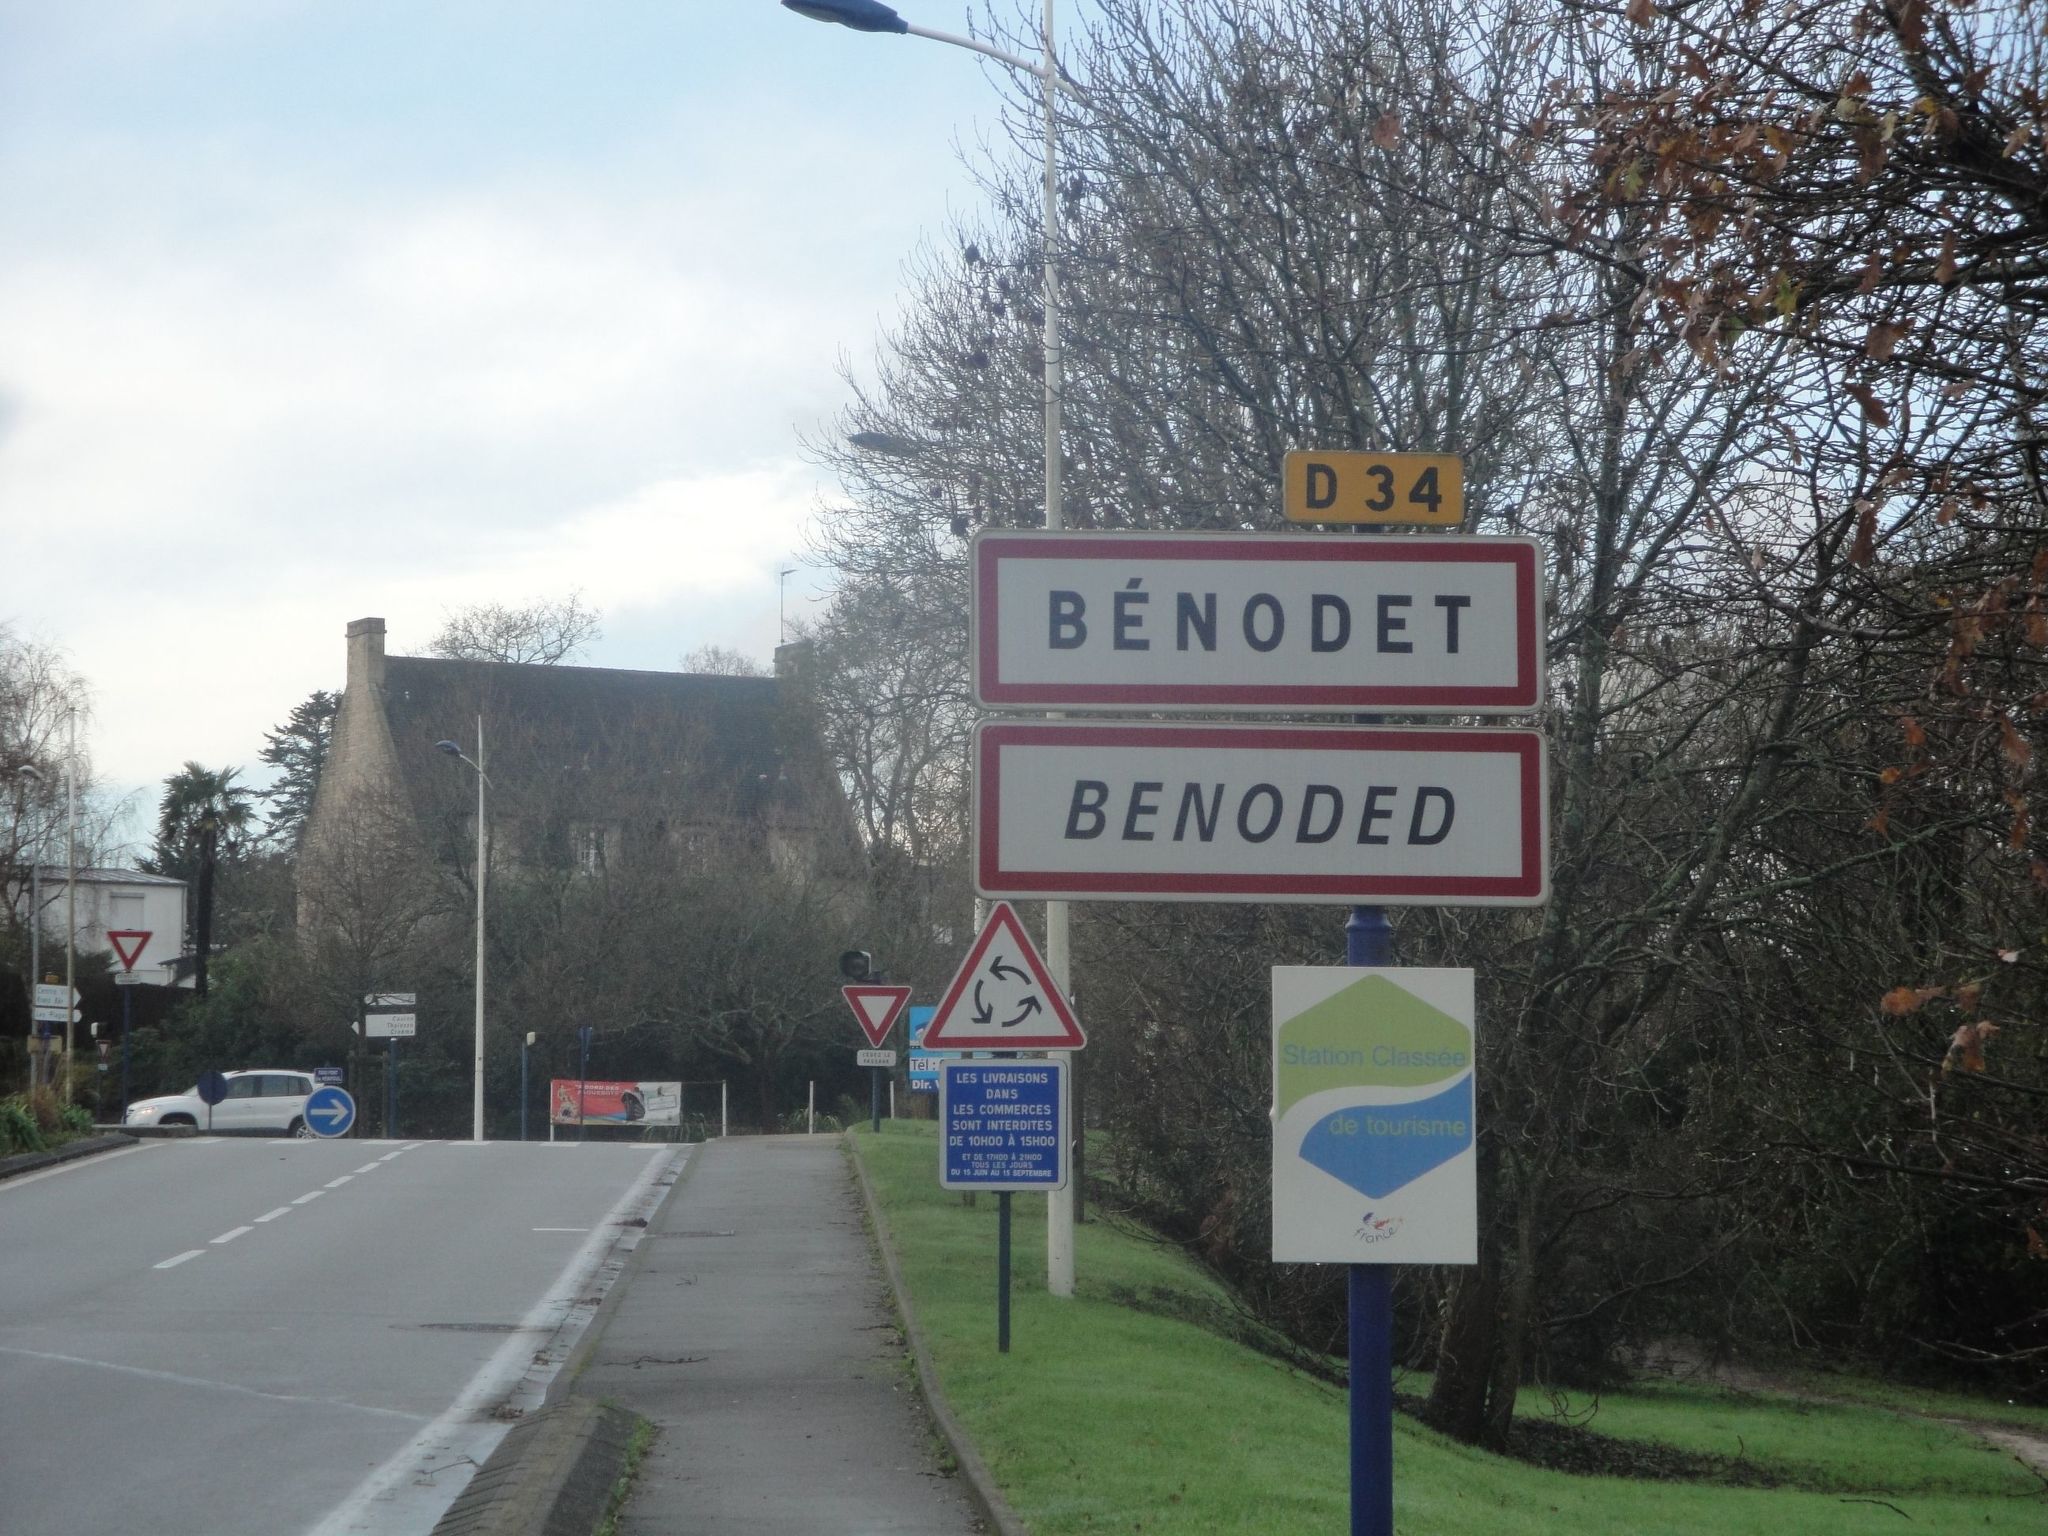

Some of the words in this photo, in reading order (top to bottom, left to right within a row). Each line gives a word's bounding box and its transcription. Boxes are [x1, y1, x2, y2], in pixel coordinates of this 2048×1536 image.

[1305, 463, 1338, 510] D
[1365, 464, 1443, 513] 34
[1048, 577, 1472, 655] BÉNODET
[1063, 779, 1456, 846] BENODED
[1283, 1044, 1364, 1067] Station
[1372, 1045, 1467, 1068] Classée
[911, 1058, 929, 1071] Tél
[956, 1072, 977, 1084] LES
[982, 1072, 1049, 1084] LIVRAISONS
[985, 1088, 1019, 1100] DANS
[953, 1104, 974, 1115] LES
[979, 1104, 1052, 1115] COMMERCES
[952, 1120, 982, 1131] SONT
[987, 1120, 1053, 1131] INTERDITES
[1329, 1115, 1359, 1136] de
[1366, 1116, 1467, 1138] tourisme
[949, 1136, 964, 1146] DE
[968, 1135, 1003, 1147] 10H00
[1007, 1133, 1016, 1146] À
[1020, 1135, 1056, 1147] 15H00
[962, 1153, 971, 1161] ET
[974, 1153, 983, 1161] DE
[971, 1161, 989, 1169] TOUS
[992, 1161, 1006, 1169] LES
[1009, 1161, 1033, 1169] JOURS
[1012, 1169, 1052, 1177] SEPTEMBRE
